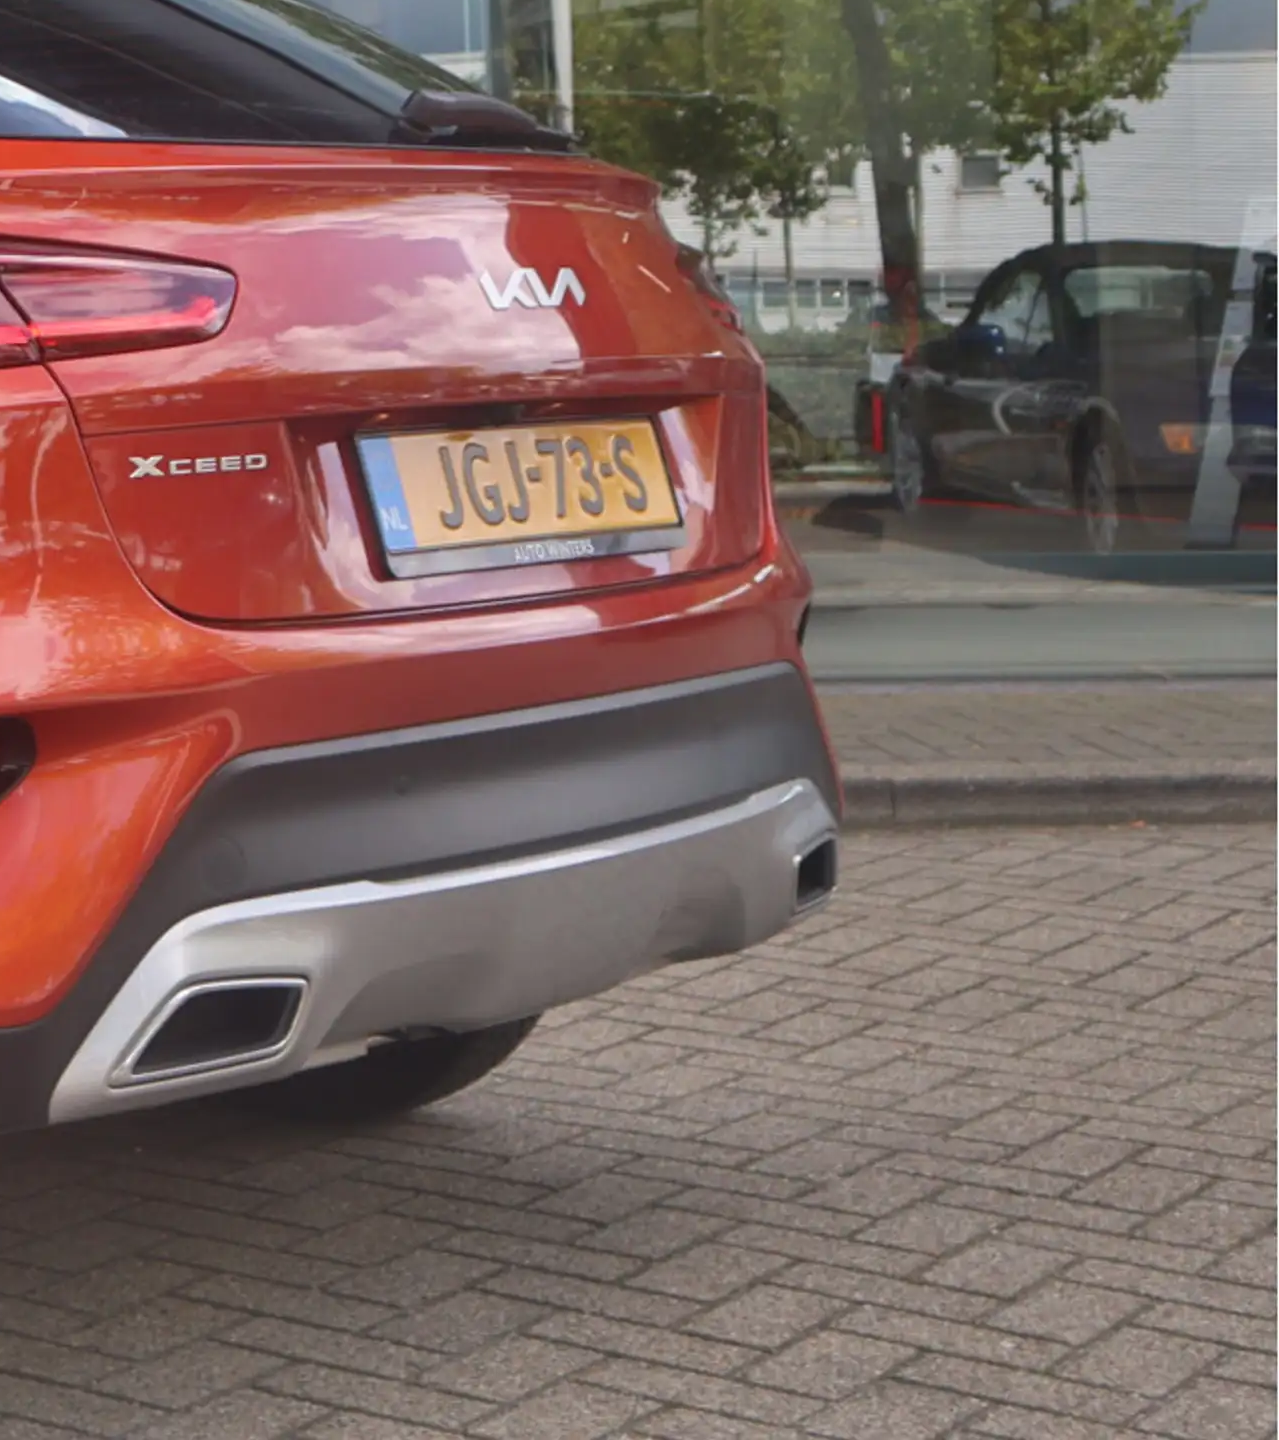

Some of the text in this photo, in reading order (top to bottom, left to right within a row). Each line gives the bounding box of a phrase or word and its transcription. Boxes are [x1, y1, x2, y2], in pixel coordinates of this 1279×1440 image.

[479, 267, 586, 310] KIA
[438, 433, 649, 530] JGJ-73-S
[380, 504, 409, 532] NL
[514, 542, 545, 563] AUTO
